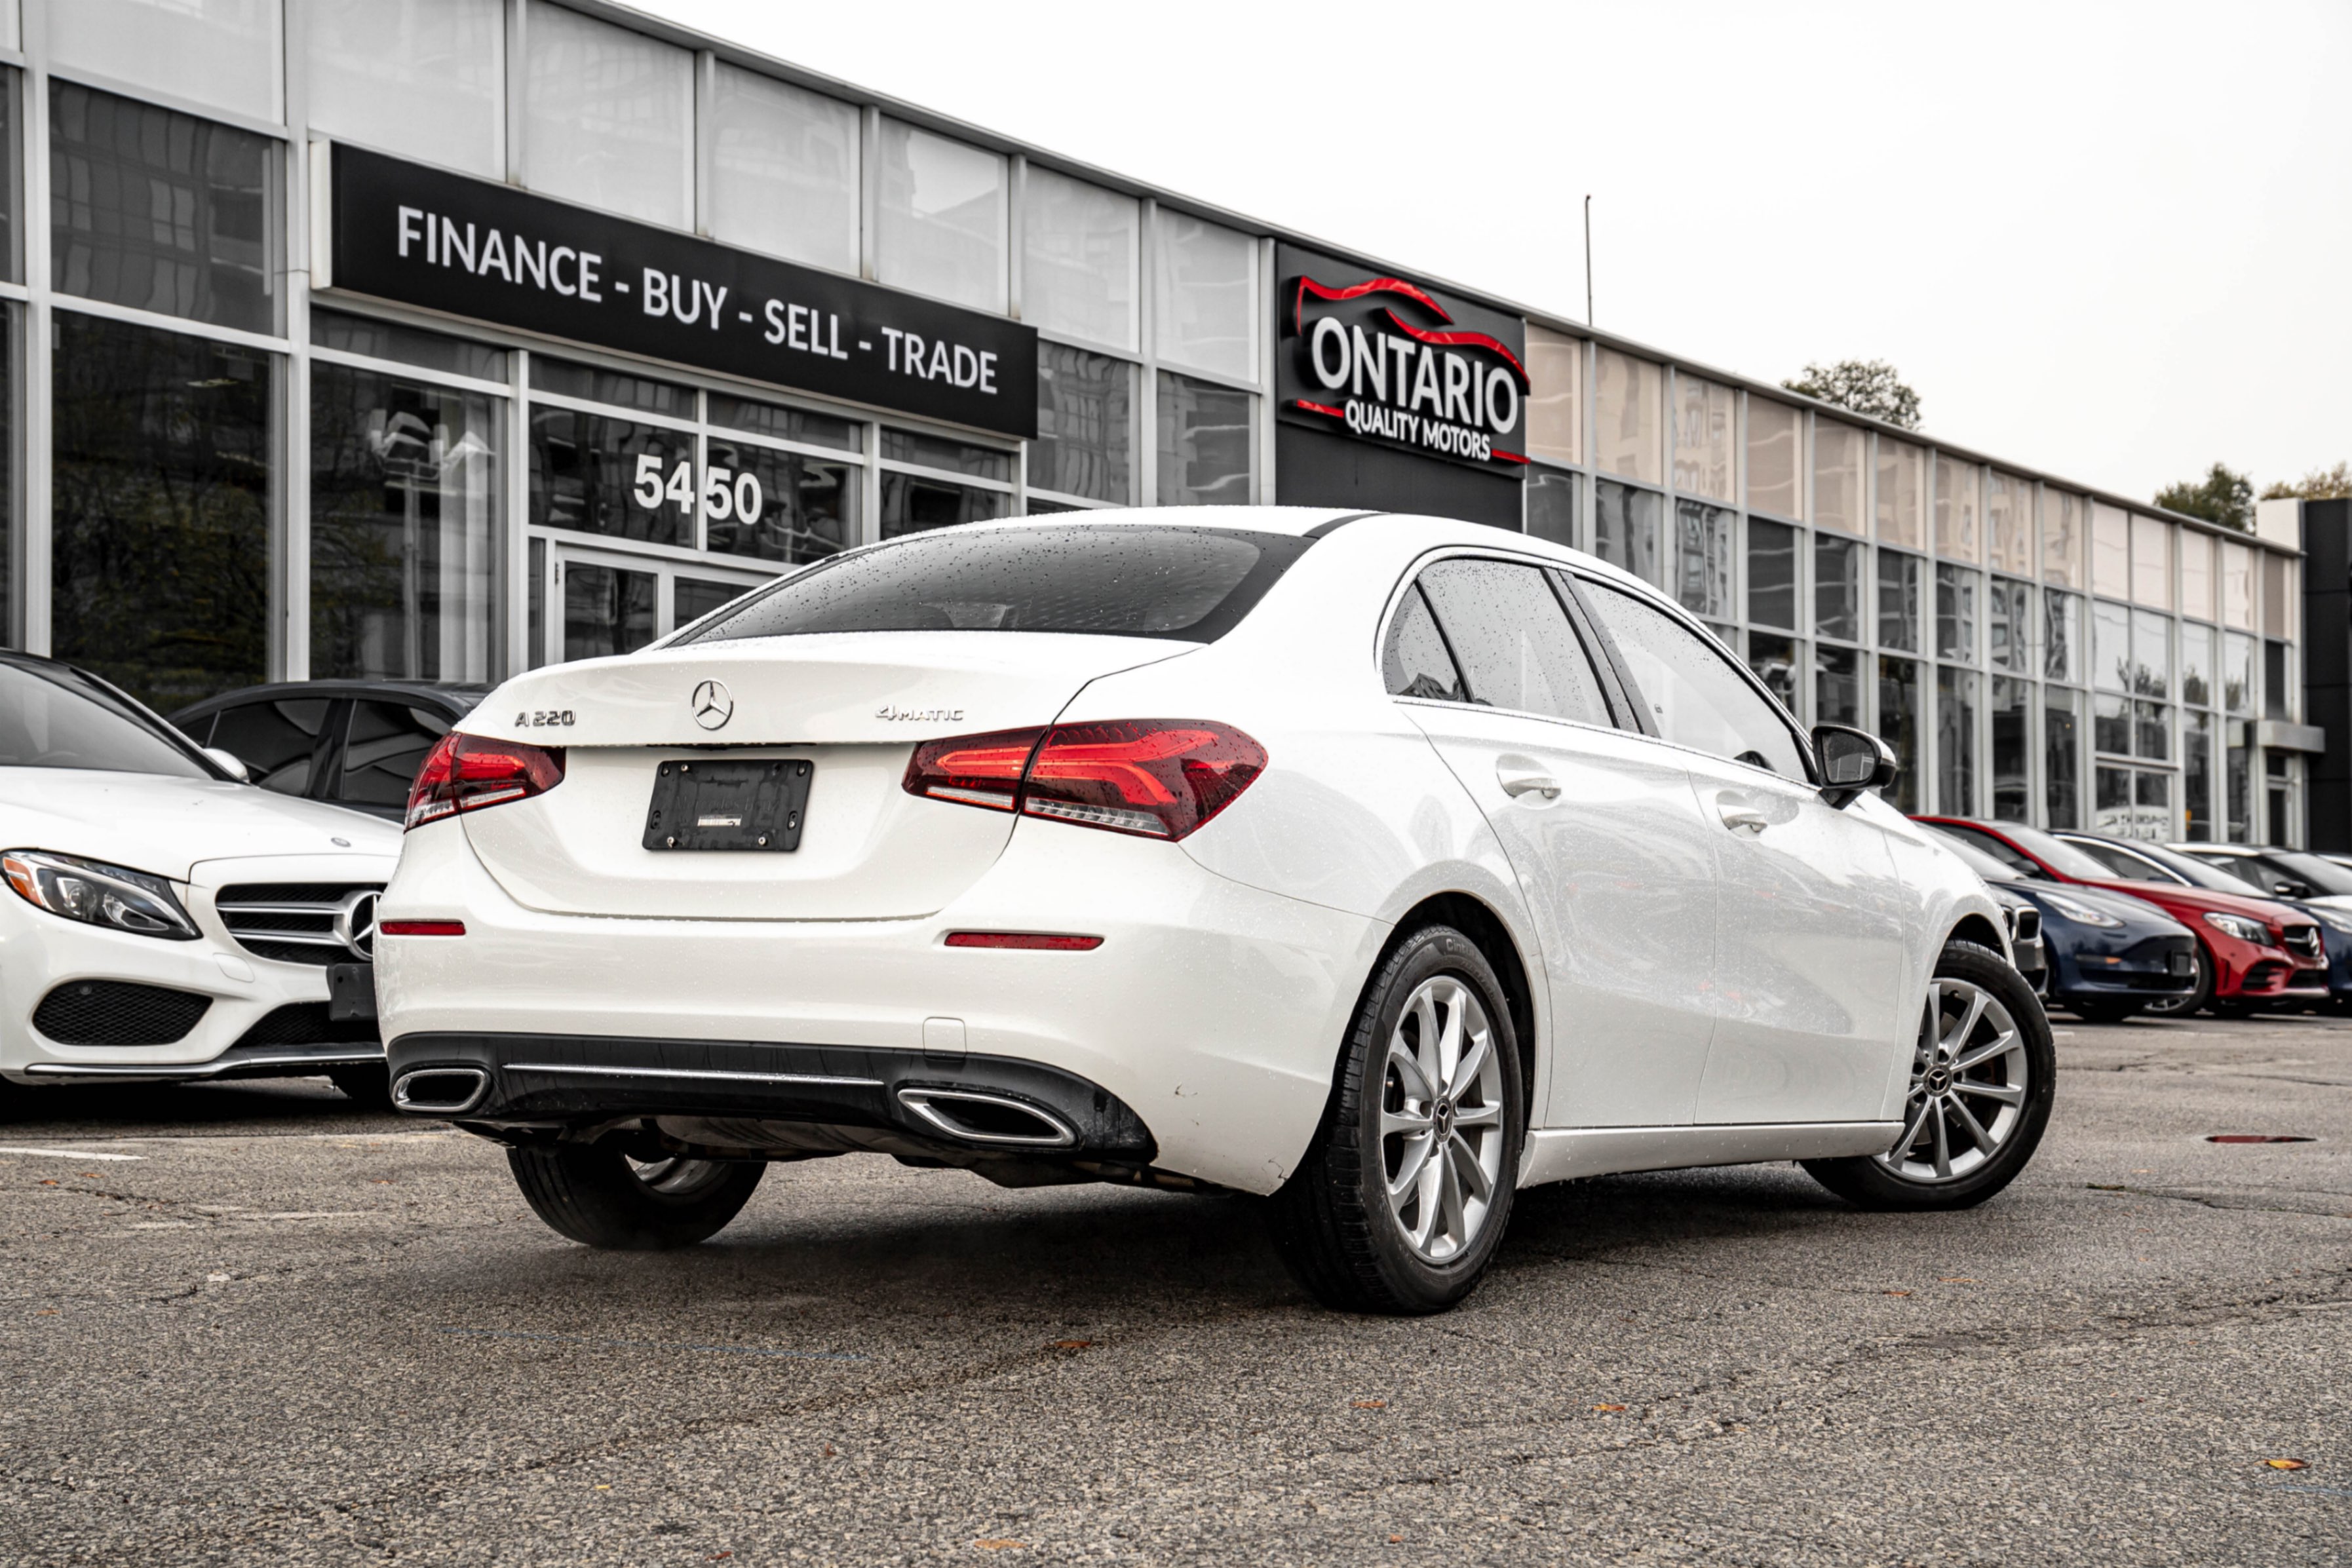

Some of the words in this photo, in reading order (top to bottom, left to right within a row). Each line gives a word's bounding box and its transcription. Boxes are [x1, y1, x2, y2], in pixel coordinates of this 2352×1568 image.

[398, 204, 602, 303] FINANCE
[644, 267, 727, 330] BUY
[764, 298, 848, 360] SELL
[881, 326, 997, 394] TRADE
[1312, 316, 1518, 434] ONTARIO
[1345, 399, 1419, 443] QUALITY
[1422, 419, 1492, 461] MOTORS
[634, 453, 762, 525] 5450
[514, 712, 530, 727] A
[533, 710, 576, 727] 220
[875, 705, 964, 722] 4MATIC
